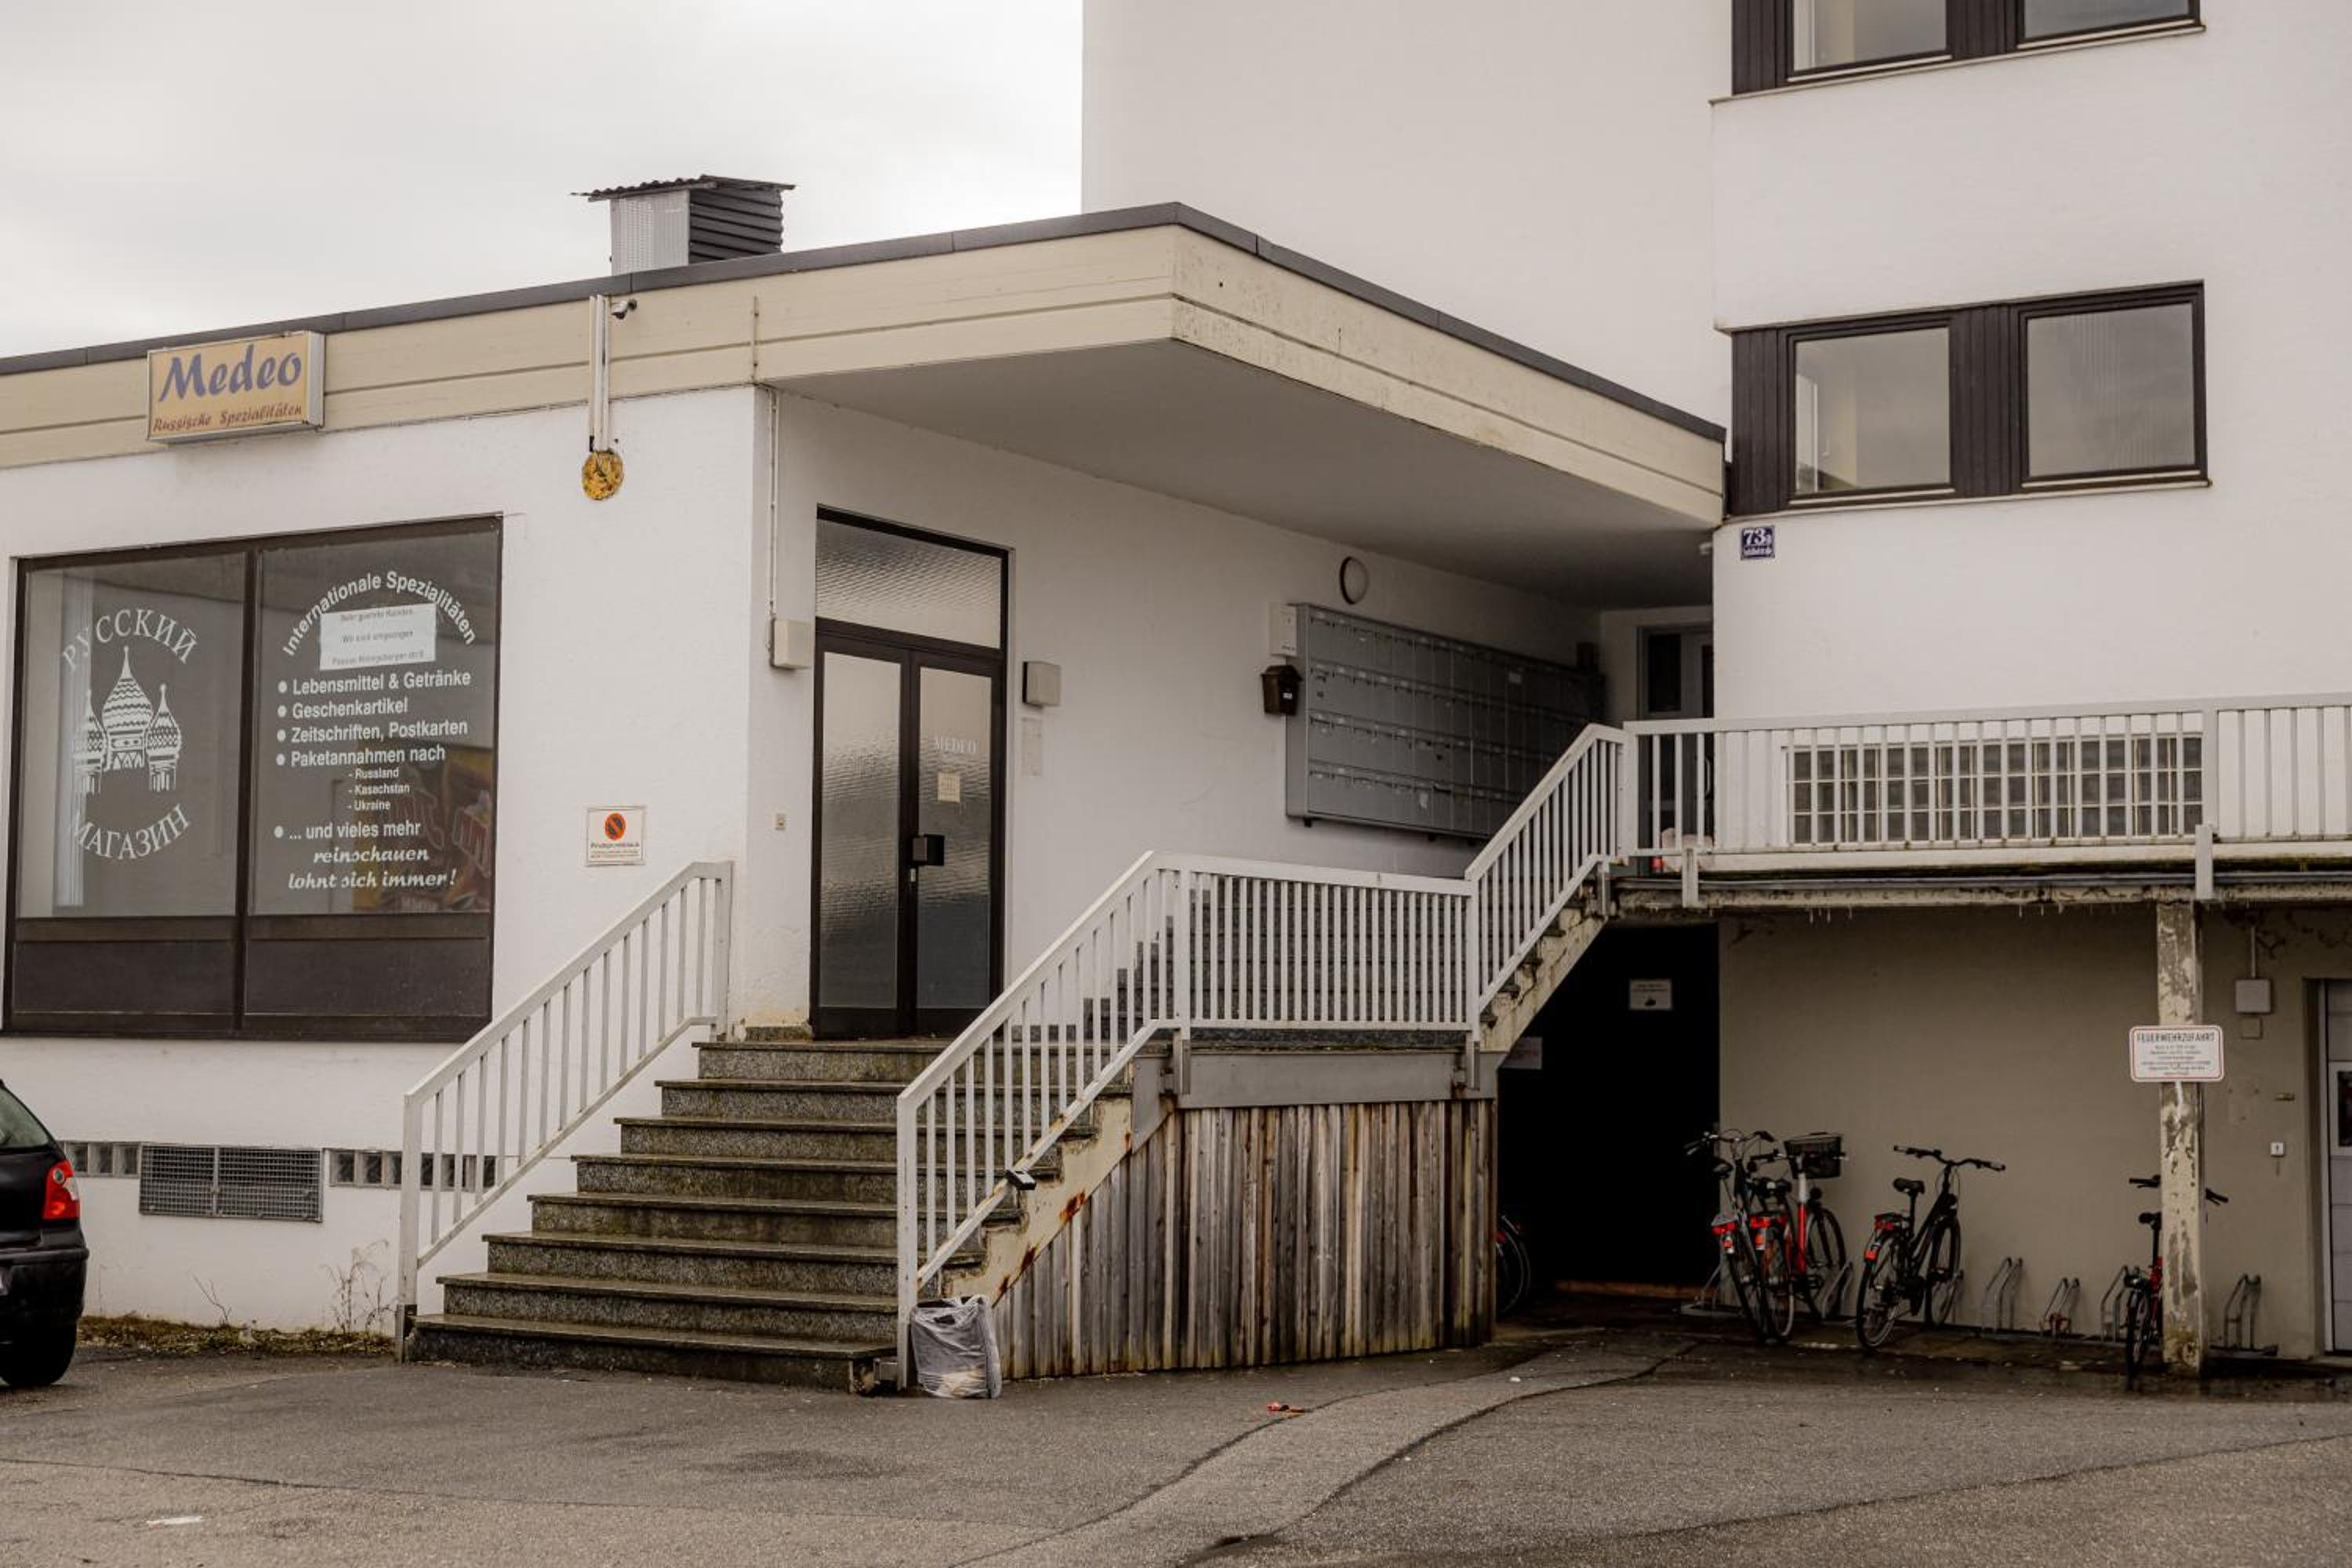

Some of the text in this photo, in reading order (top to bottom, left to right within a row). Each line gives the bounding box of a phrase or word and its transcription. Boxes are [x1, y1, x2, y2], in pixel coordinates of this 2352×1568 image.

[159, 344, 302, 401] Medeo
[153, 401, 302, 431] Russische Spezialitäten
[283, 571, 476, 656] Internationale Spezialitäten
[63, 609, 198, 671] РУССКИЙ
[292, 670, 471, 695] Lebensmittel & Getränke
[292, 697, 408, 719] Geschenkartikel
[291, 720, 468, 742] Zeitschriften, Postkarten
[291, 745, 446, 767] Paketannahmen nach
[74, 804, 191, 860] МАГАЗИН
[306, 825, 333, 840] und
[337, 821, 379, 838] vieles
[383, 820, 421, 837] mehr
[313, 845, 430, 863] reinschauen
[288, 873, 337, 889] lohnt
[341, 869, 377, 888] sich
